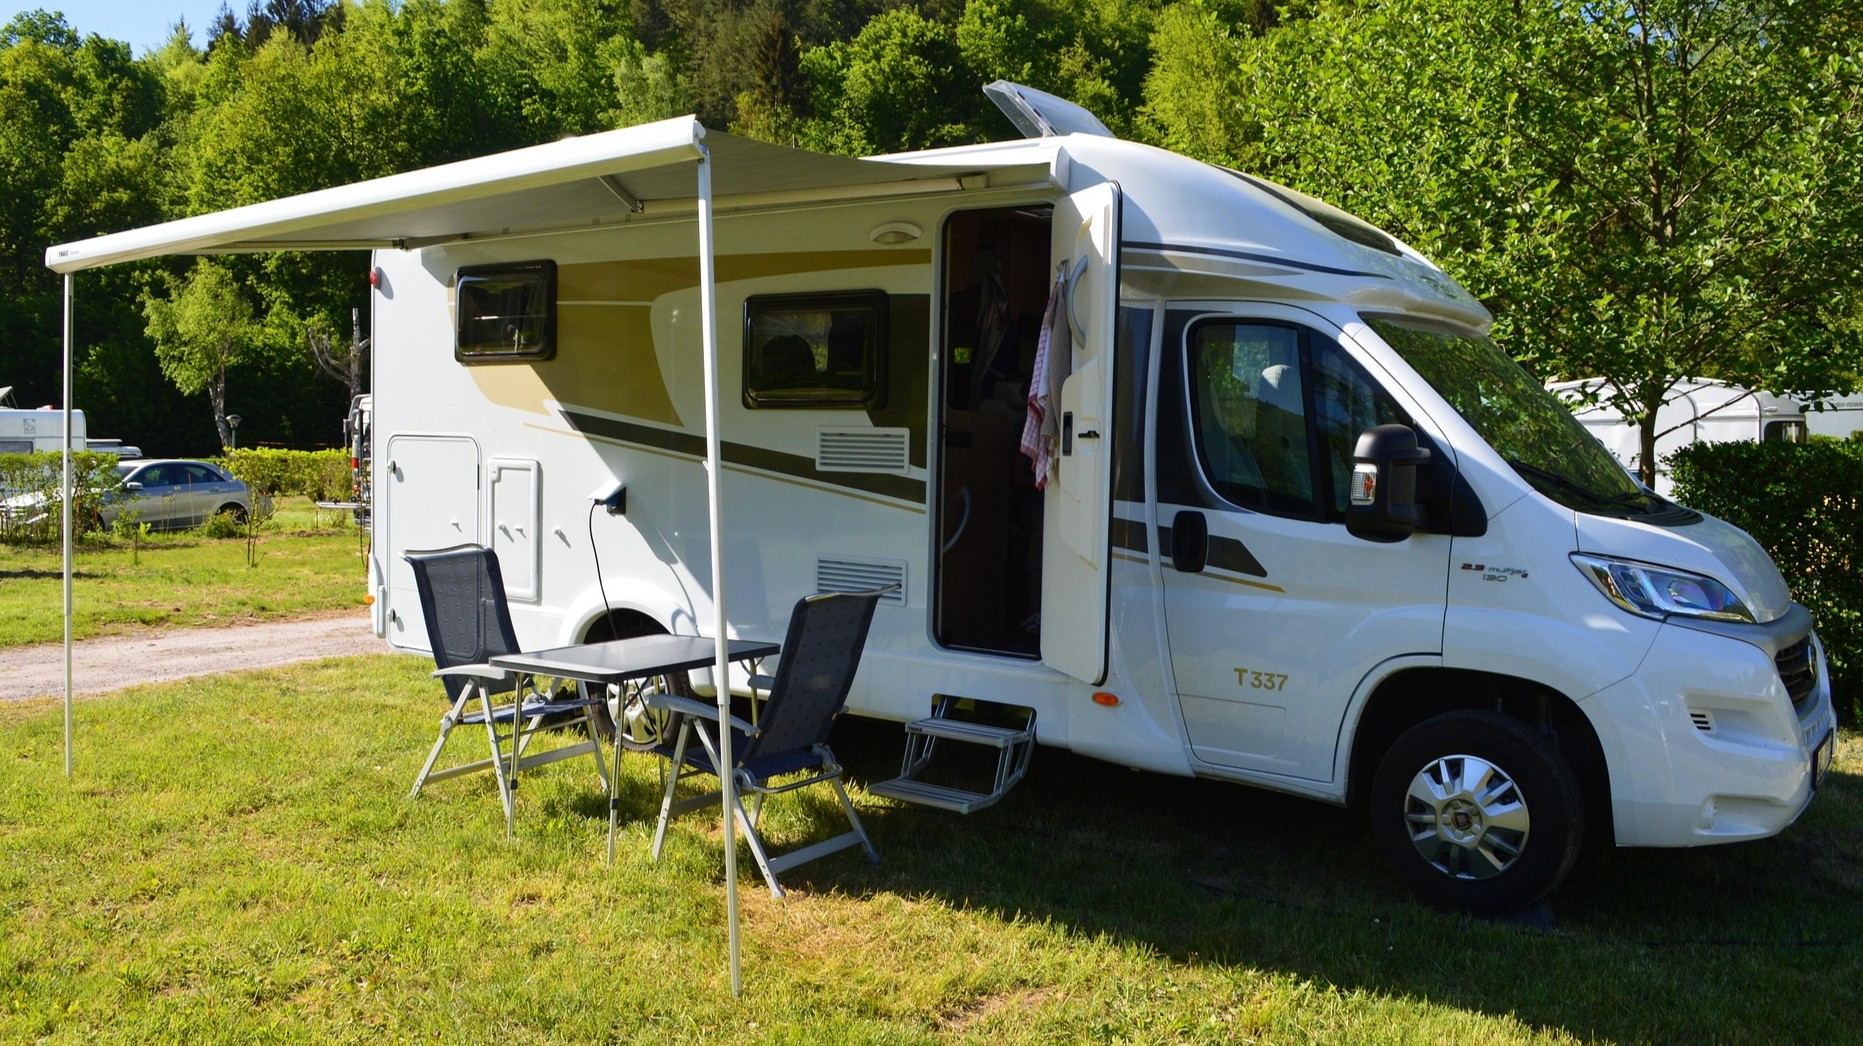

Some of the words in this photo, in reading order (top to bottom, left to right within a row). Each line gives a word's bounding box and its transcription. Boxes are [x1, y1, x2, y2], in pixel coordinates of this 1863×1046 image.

[1483, 574, 1507, 582] 130
[1233, 667, 1248, 686] T
[1250, 670, 1288, 691] 337
